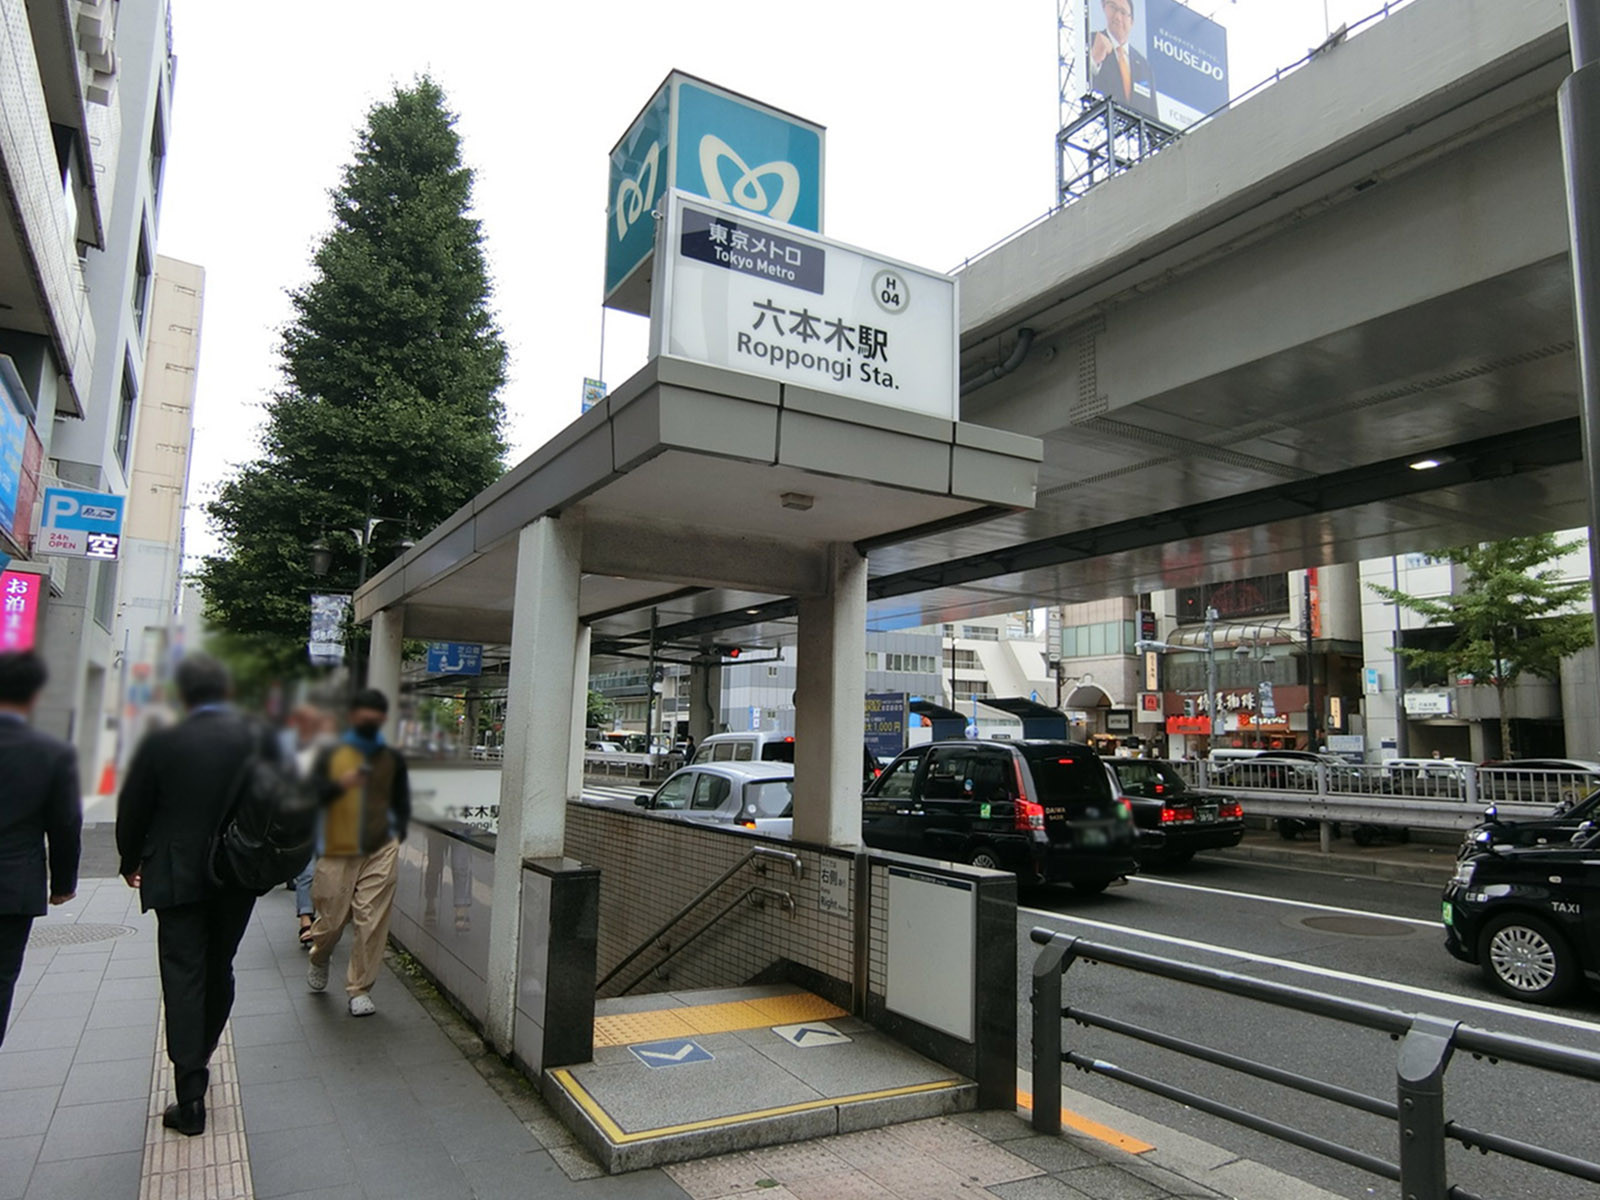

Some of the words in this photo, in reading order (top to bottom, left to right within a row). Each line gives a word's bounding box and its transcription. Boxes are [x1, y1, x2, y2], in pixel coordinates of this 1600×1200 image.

[708, 222, 801, 267] 東京メトロ
[713, 245, 753, 273] Tokyo
[757, 258, 796, 281] Metro
[885, 277, 896, 290] H
[880, 289, 900, 308] 04
[752, 298, 889, 363] 六本木駅
[737, 330, 852, 382] Roppongi
[860, 363, 900, 391] Sta.
[46, 494, 79, 528] P
[48, 541, 77, 550] OPEN
[49, 532, 69, 541] 24h
[86, 533, 118, 559] 空
[1551, 901, 1581, 914] TAXI
